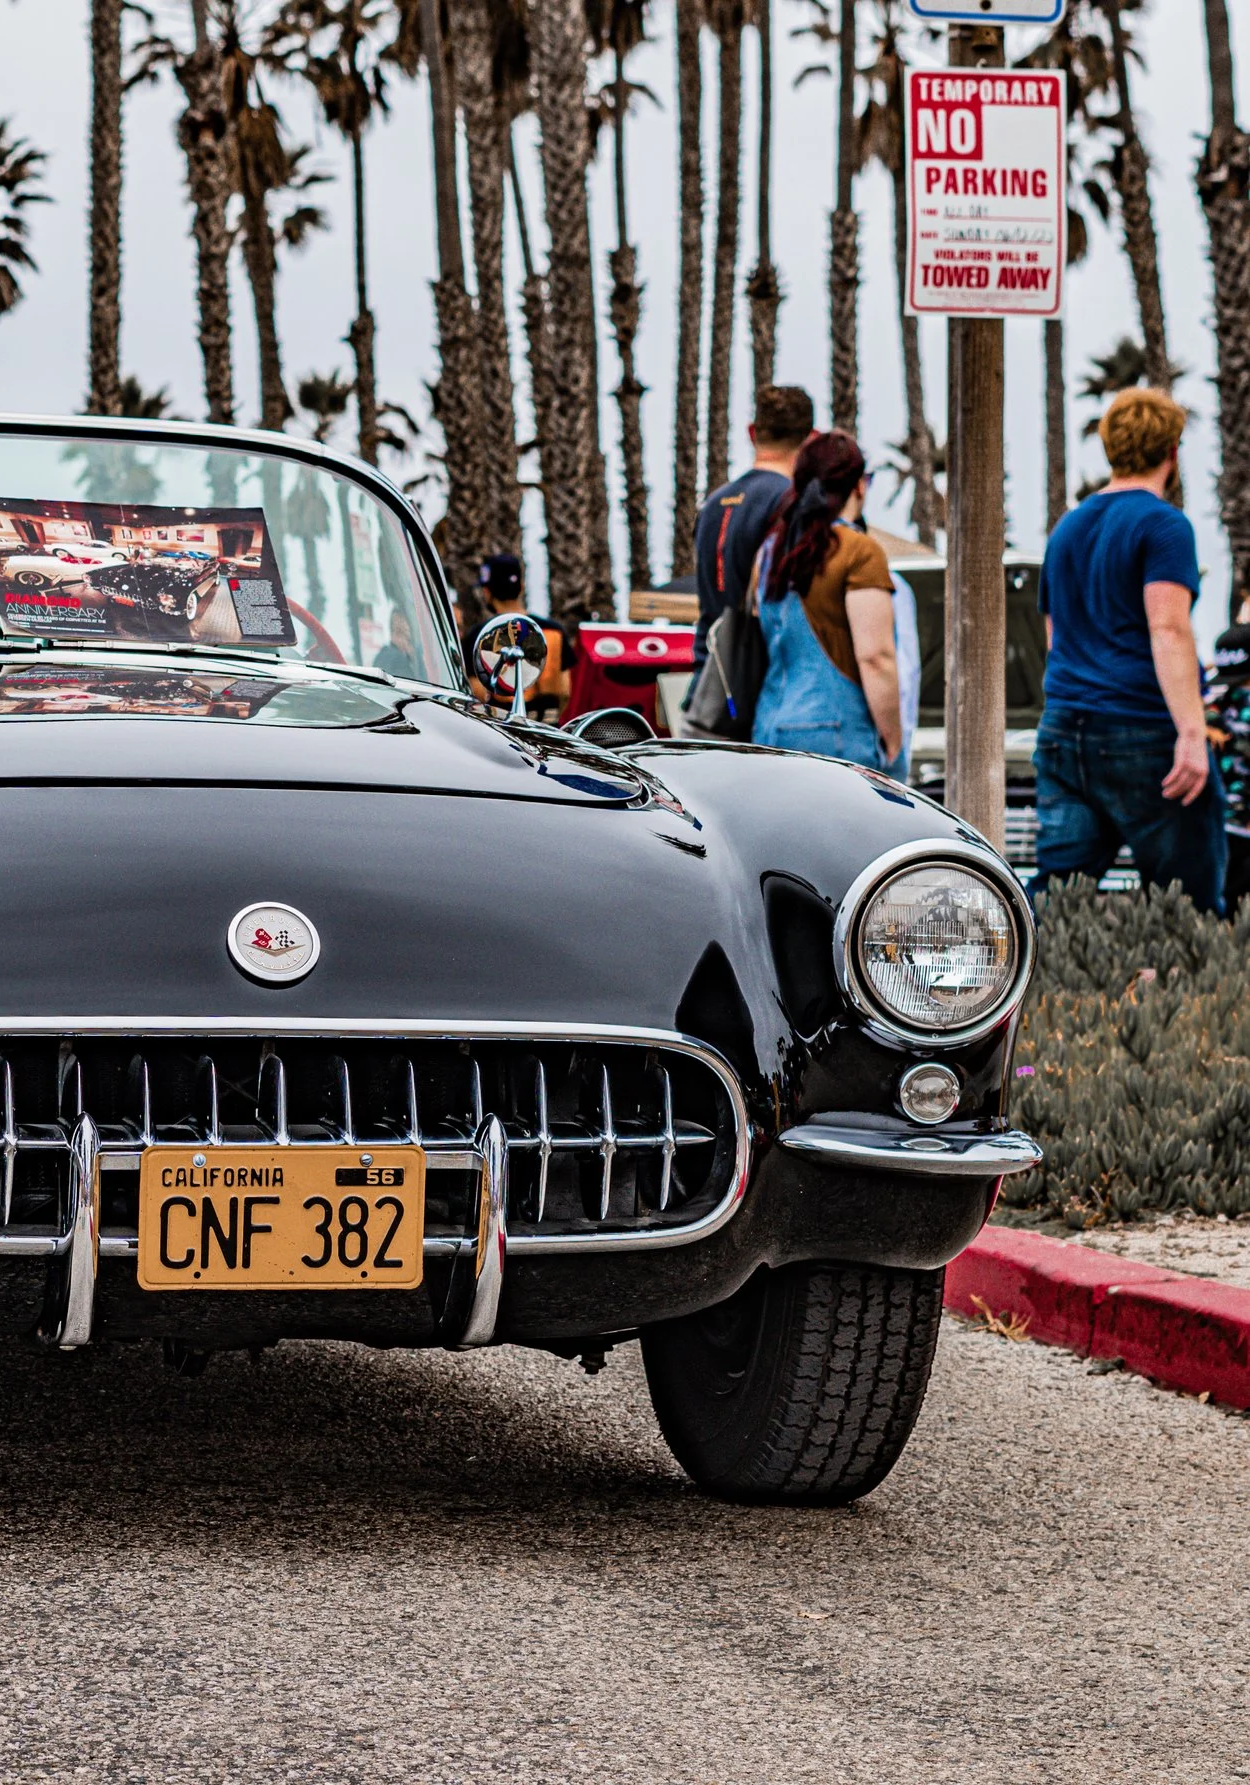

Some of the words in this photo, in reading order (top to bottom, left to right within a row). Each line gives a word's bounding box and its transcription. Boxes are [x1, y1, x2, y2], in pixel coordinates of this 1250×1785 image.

[918, 78, 1053, 104] TEMPORARY
[917, 108, 976, 154] NO
[925, 167, 1048, 198] PARKING
[934, 249, 992, 261] VIOLATORS
[996, 250, 1020, 262] WILL
[1025, 251, 1039, 262] BE
[921, 264, 989, 288] TOWED
[997, 267, 1051, 290] AWAY
[5, 593, 81, 607] DIAMOND
[6, 603, 105, 618] ANNIVERSARY
[162, 1167, 284, 1187] CALIFORNIA
[366, 1169, 394, 1185] 56
[160, 1196, 281, 1270] CNF
[301, 1196, 405, 1269] 382
